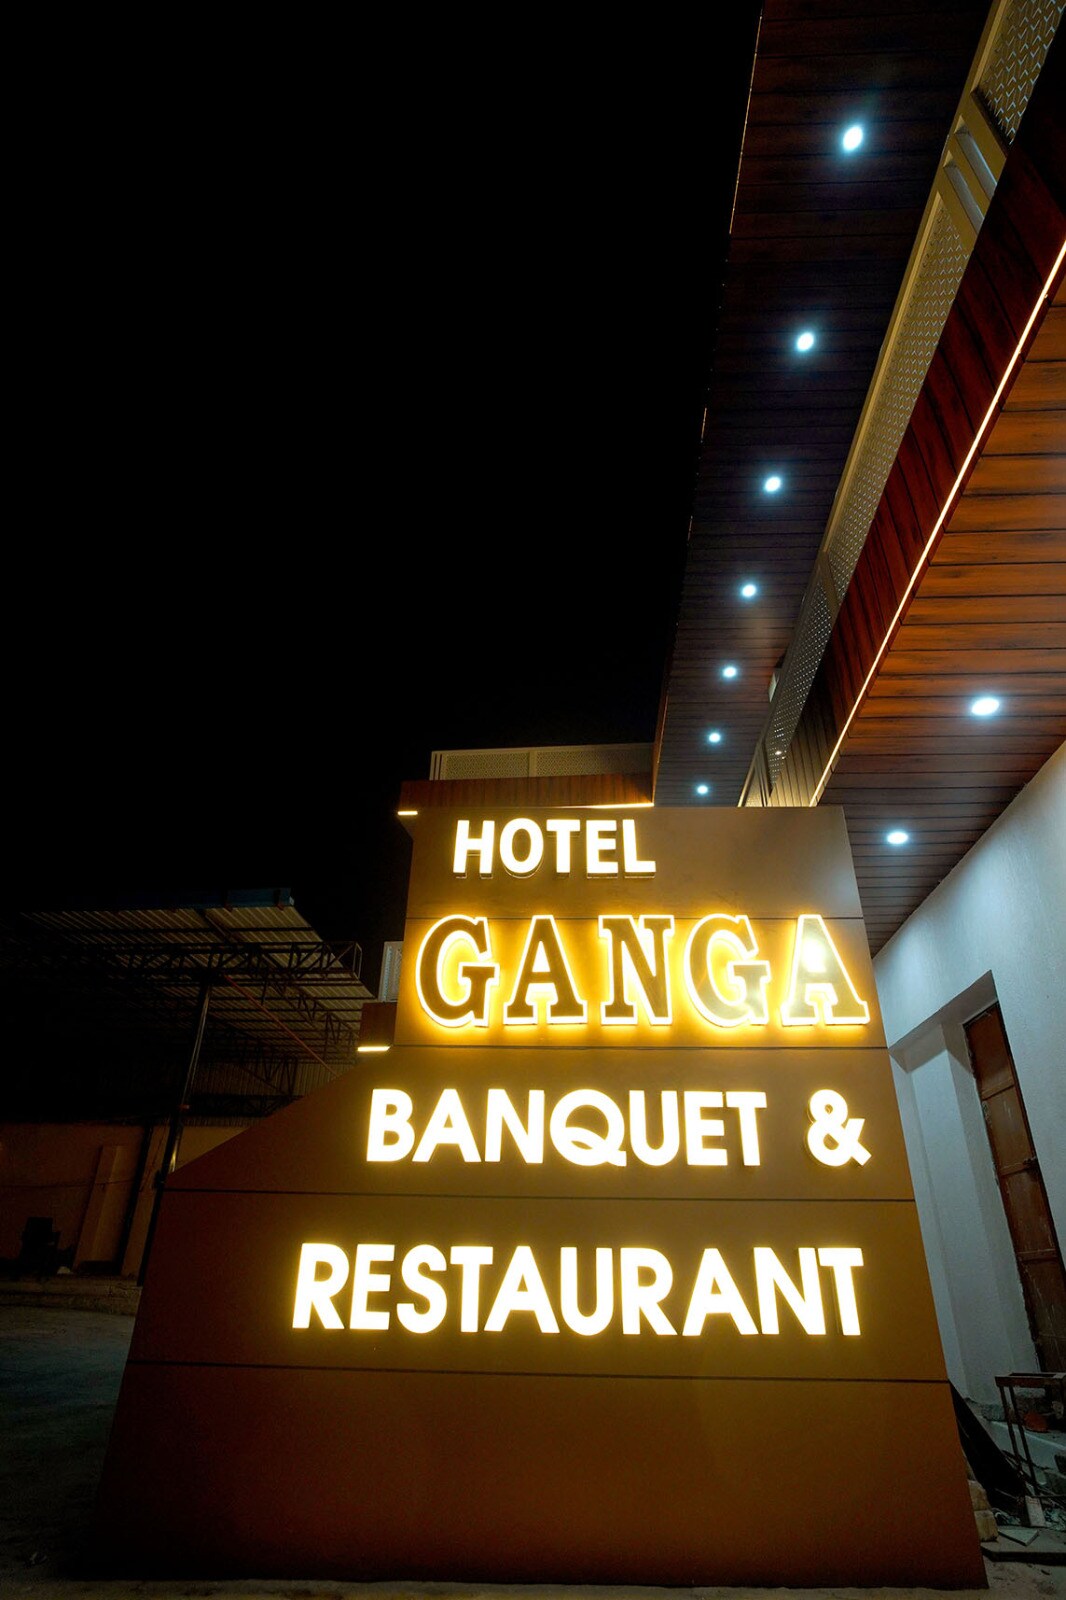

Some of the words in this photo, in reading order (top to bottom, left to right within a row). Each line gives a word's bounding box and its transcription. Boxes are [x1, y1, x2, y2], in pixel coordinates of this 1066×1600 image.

[453, 817, 657, 877] HOTEL
[415, 913, 871, 1029] GANGA
[366, 1087, 767, 1168] BANQUET
[807, 1088, 872, 1167] &
[292, 1242, 864, 1337] RESTAURANT
